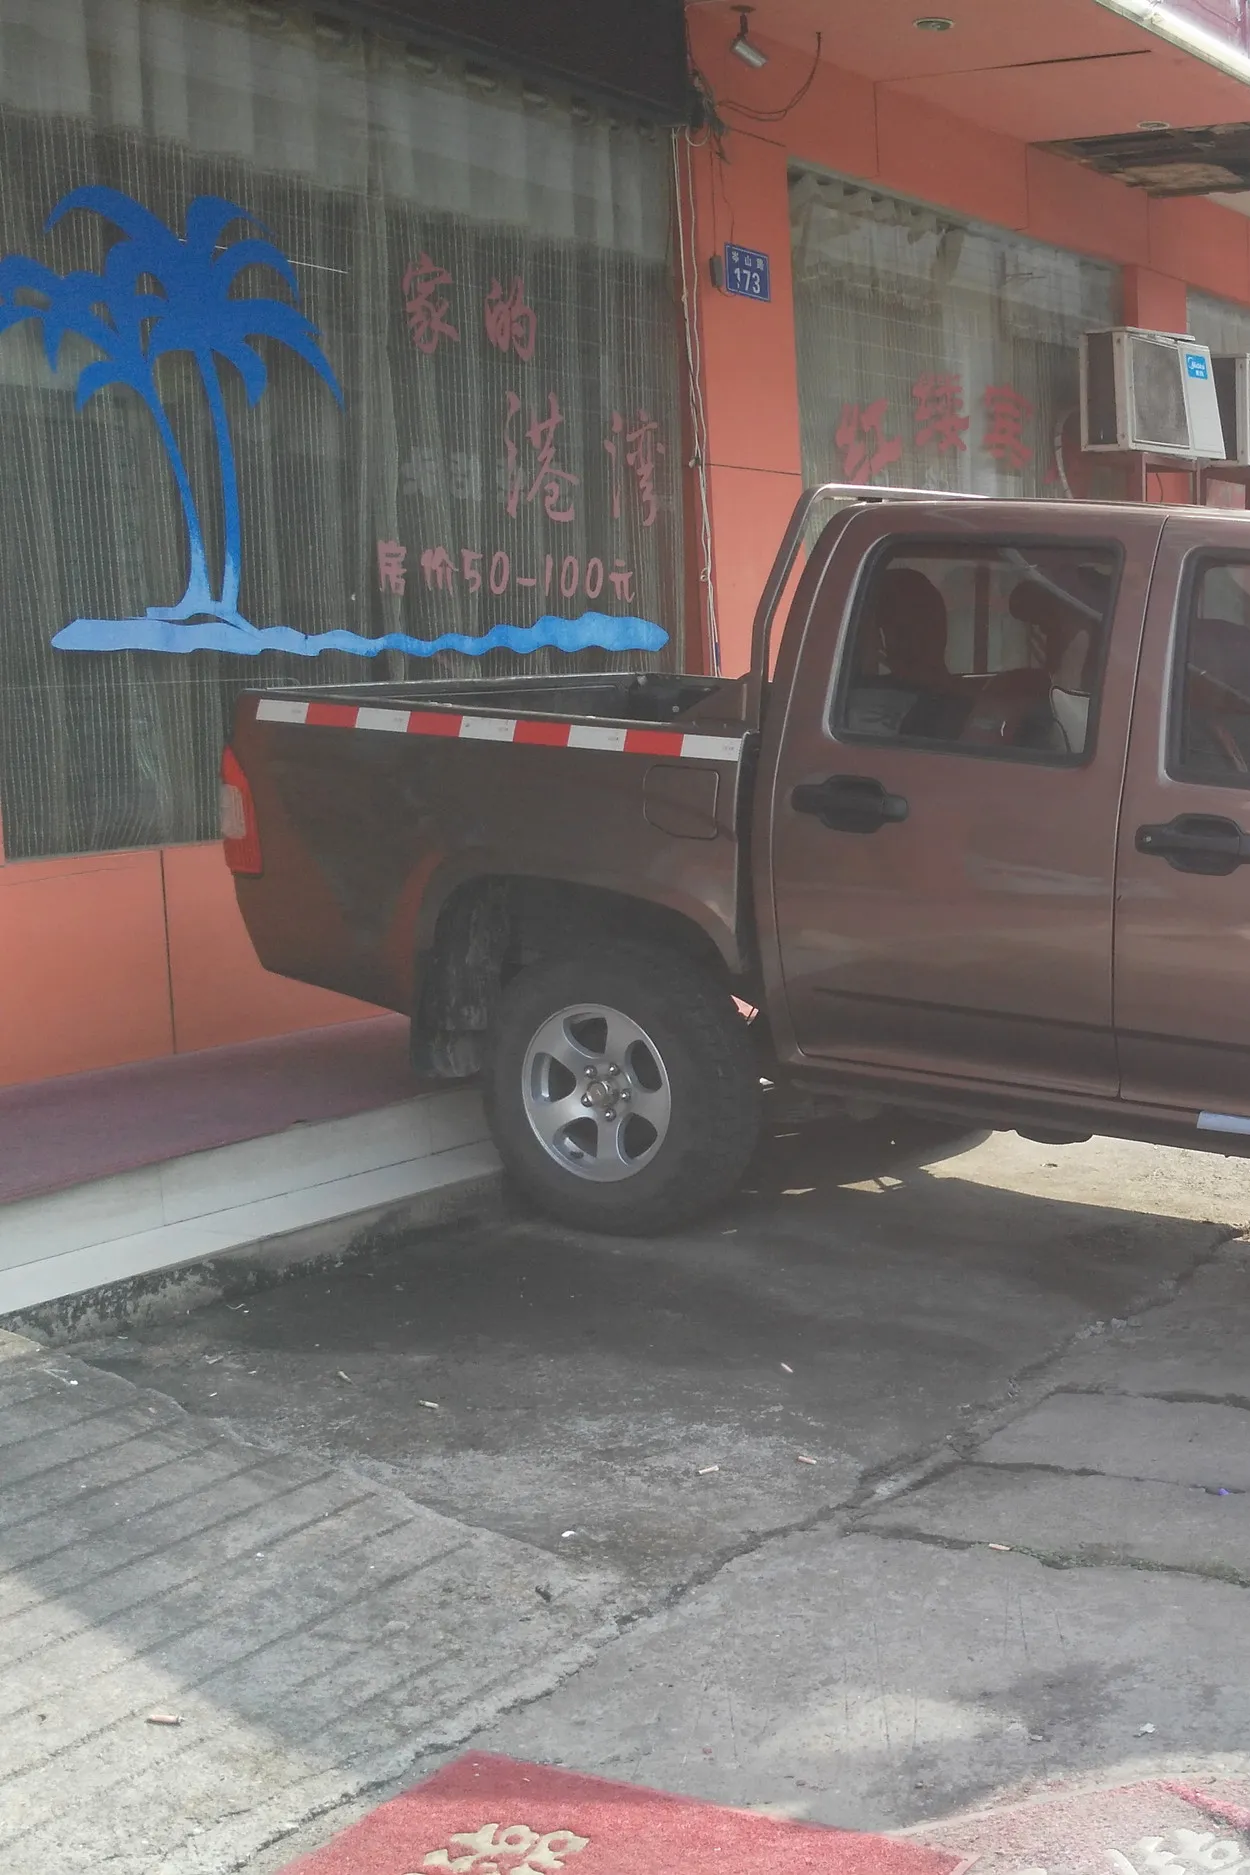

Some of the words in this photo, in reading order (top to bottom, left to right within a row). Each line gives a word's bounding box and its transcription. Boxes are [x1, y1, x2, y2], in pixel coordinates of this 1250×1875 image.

[401, 251, 537, 362] 家的
[734, 267, 762, 294] 173
[504, 391, 666, 527] 港湾
[377, 539, 636, 603] 房价50-100元
